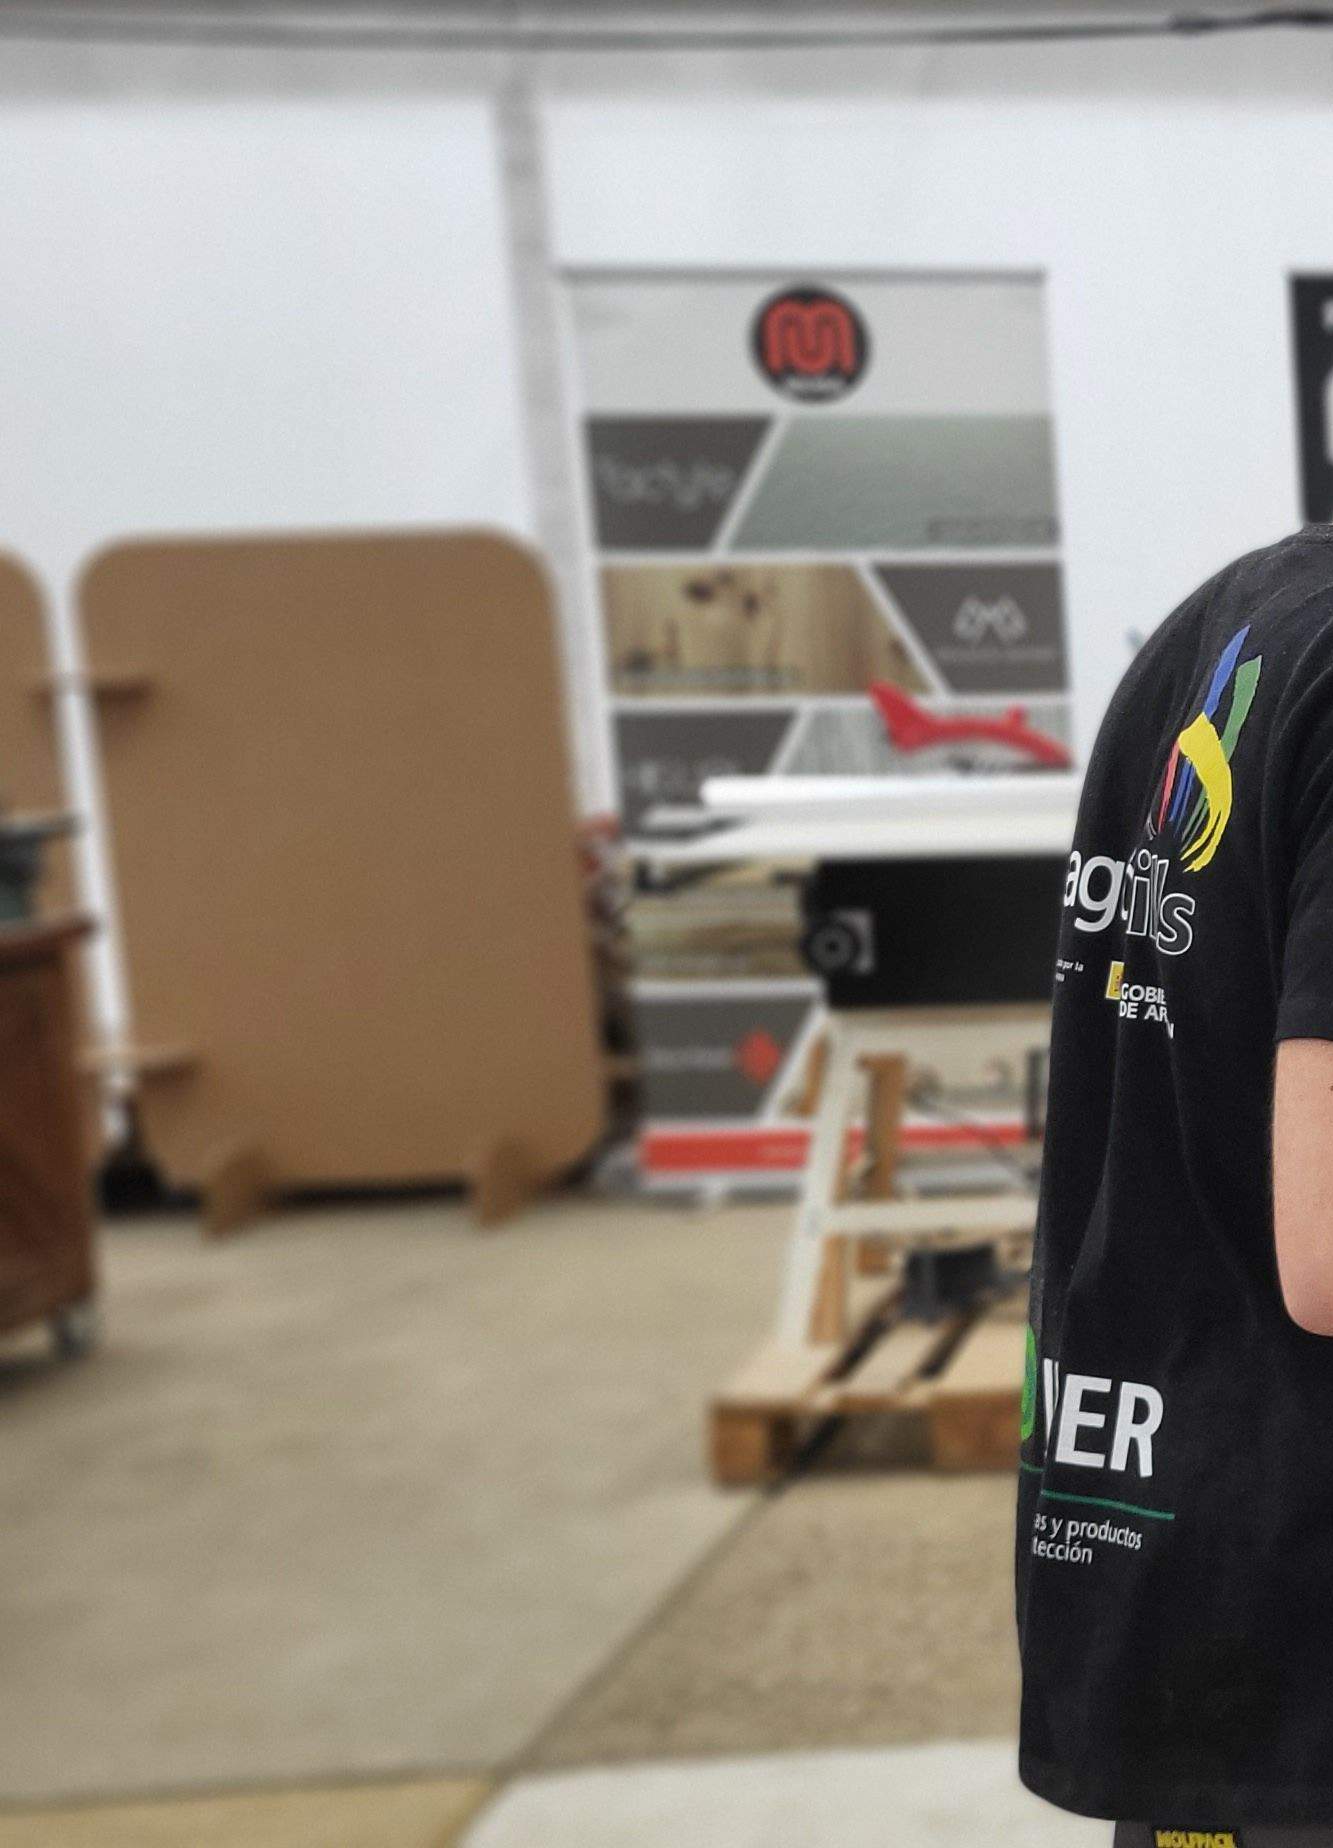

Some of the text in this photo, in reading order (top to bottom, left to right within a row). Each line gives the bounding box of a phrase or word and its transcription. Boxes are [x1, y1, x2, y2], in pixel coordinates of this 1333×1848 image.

[1119, 1000, 1139, 1019] DE
[1050, 1517, 1064, 1539] y
[1067, 1519, 1144, 1551] productos
